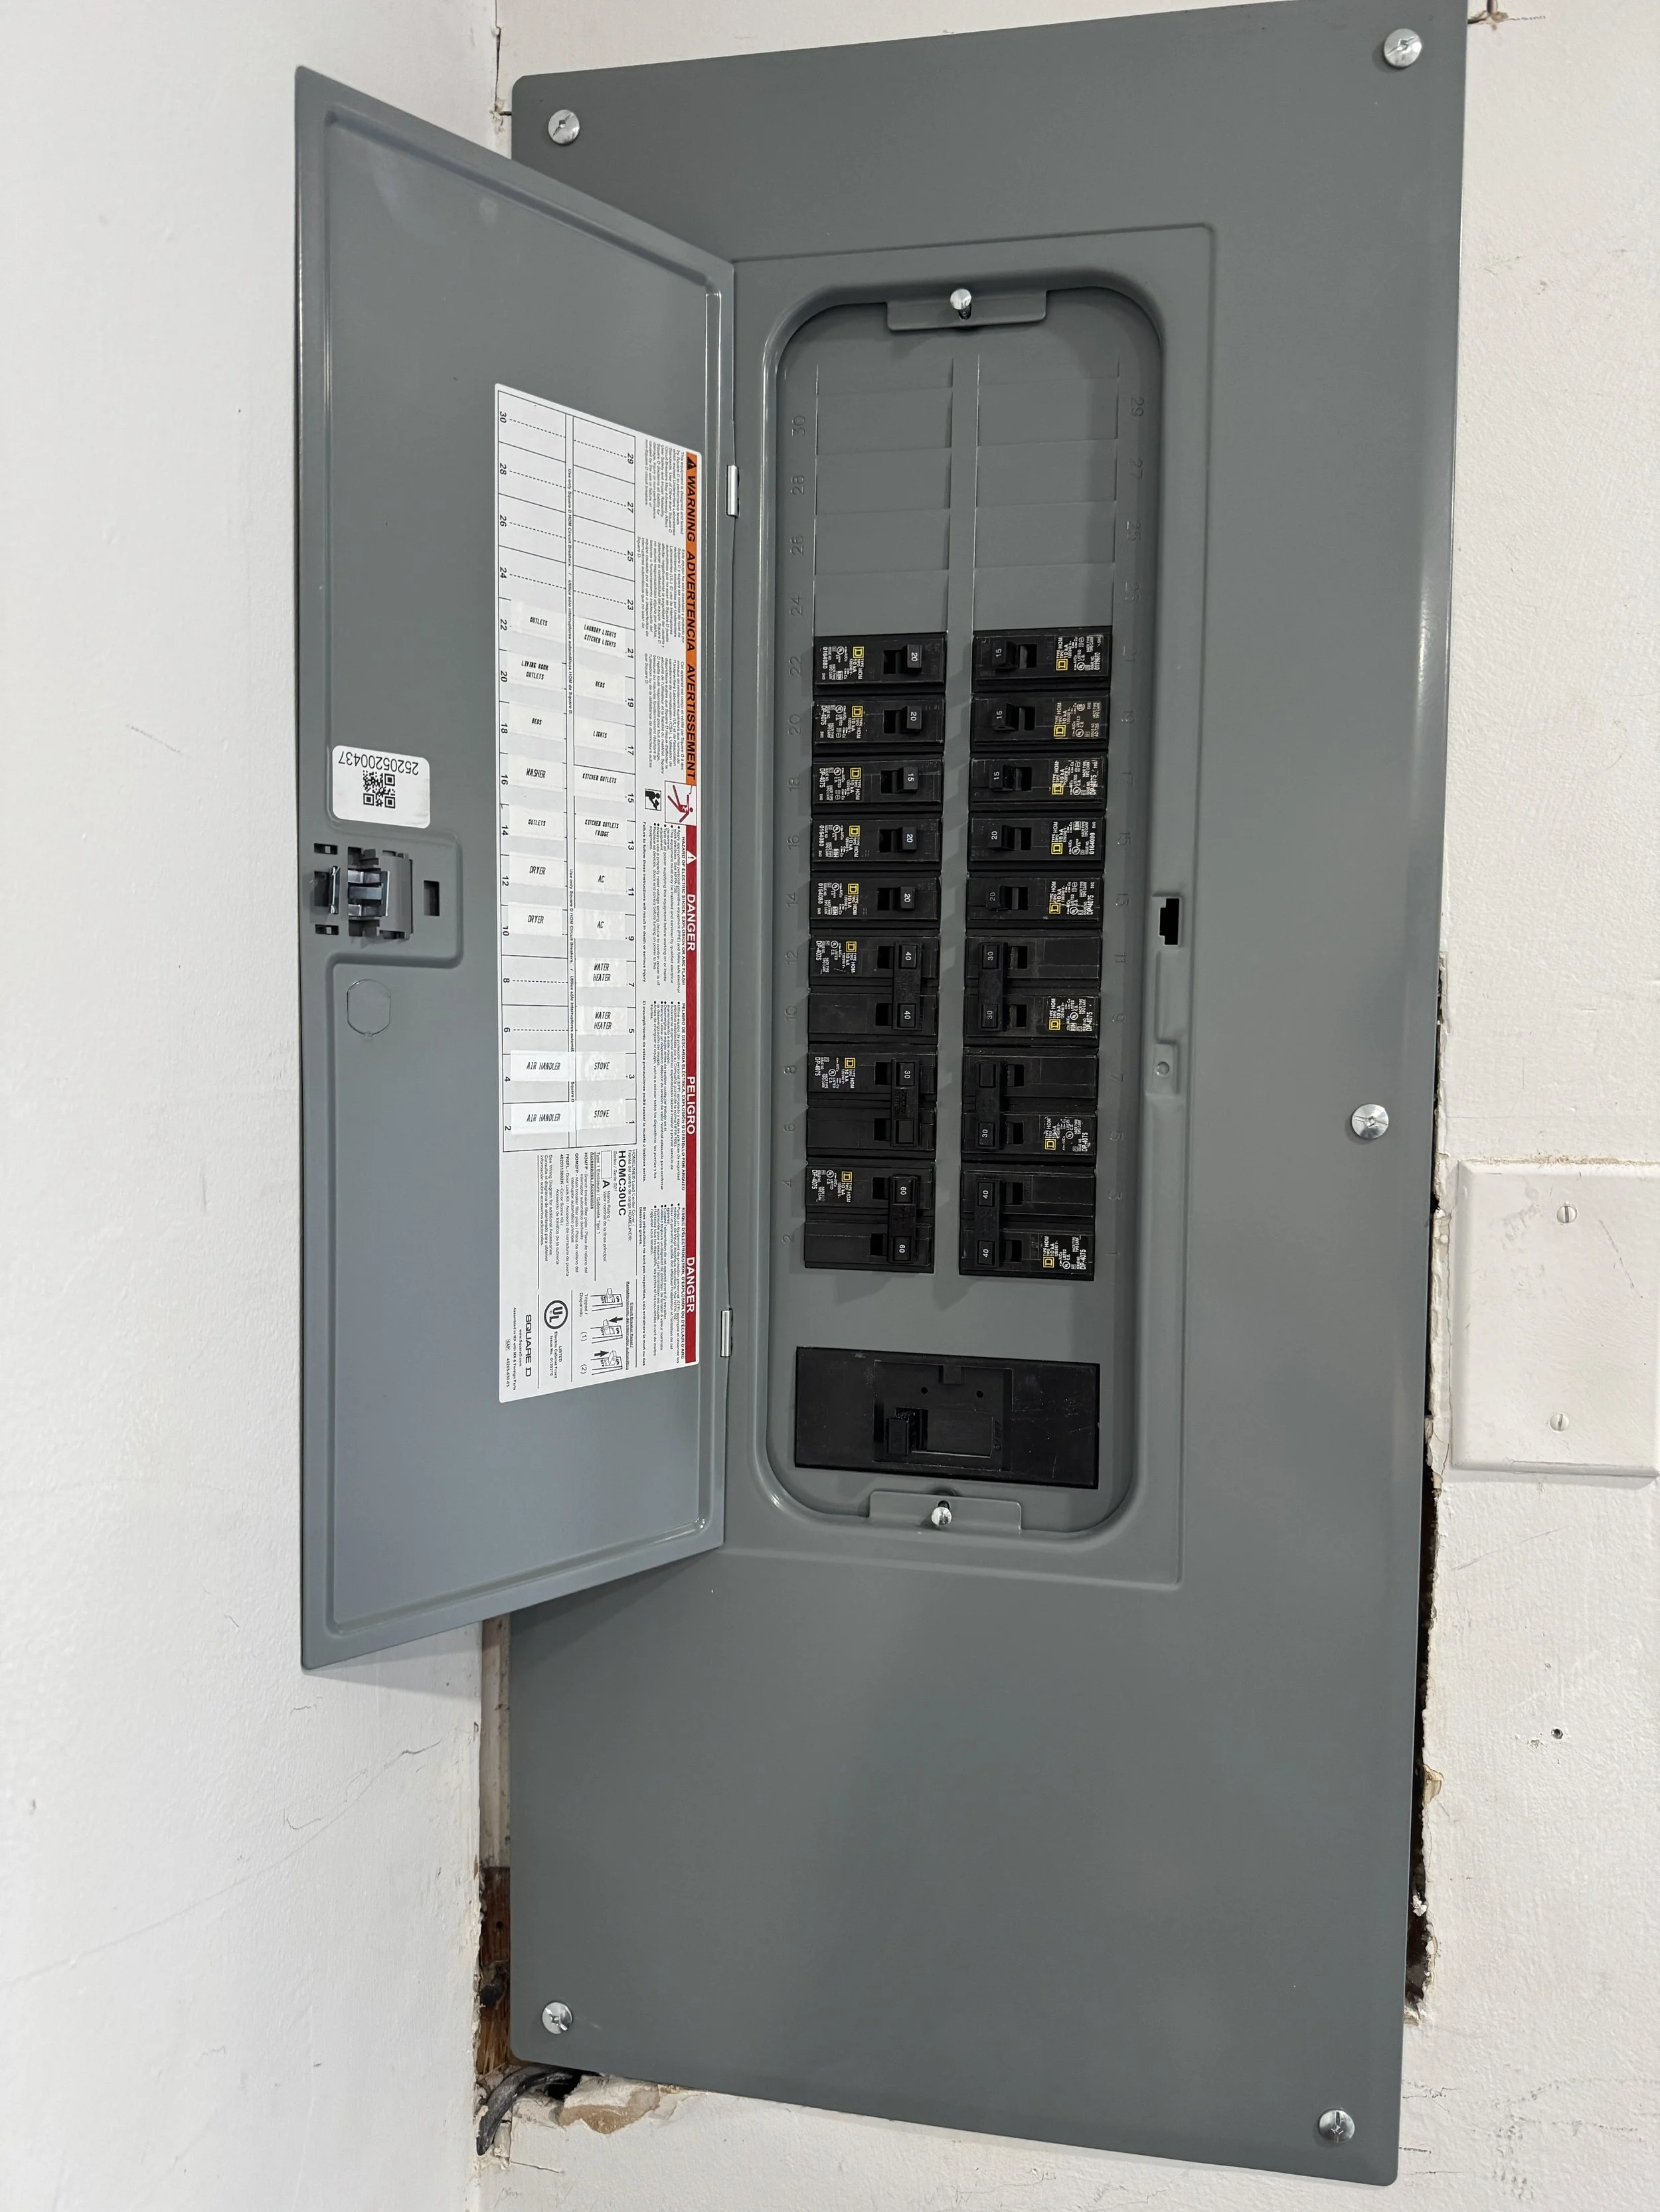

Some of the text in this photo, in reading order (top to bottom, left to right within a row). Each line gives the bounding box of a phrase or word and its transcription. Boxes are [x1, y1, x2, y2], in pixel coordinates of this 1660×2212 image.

[499, 411, 507, 424] 30
[627, 453, 634, 465] 29
[499, 463, 507, 475] 28
[627, 501, 634, 514] 27
[687, 475, 696, 542] WARNING
[499, 514, 507, 527] 26
[627, 550, 633, 562] 25
[499, 566, 507, 579] 24
[627, 599, 634, 611] 23
[687, 550, 696, 652] ADVERTENCIA
[500, 618, 507, 631] 22
[529, 616, 548, 627] OUTLETS
[584, 624, 617, 639] LAUNDRY LIGHTS
[584, 634, 617, 648] KITCHEN LIGHTS
[627, 647, 634, 659] 21
[911, 652, 918, 662] 20
[995, 649, 1002, 657] 15
[521, 660, 537, 669] LIVING
[500, 670, 508, 682] 20
[526, 671, 544, 680] OUTLETS
[627, 697, 634, 708] 19
[910, 711, 917, 722] 20
[996, 710, 1003, 720] 15
[687, 663, 696, 781] AVERTISSEMENT
[501, 723, 508, 734] 18
[592, 730, 608, 739] LIGHTS
[627, 746, 634, 756] 17
[338, 751, 419, 775] 25205200437
[526, 768, 546, 779] WASHER
[582, 773, 617, 784] KITCHEN OUTLETS
[907, 773, 914, 782] 15
[993, 771, 1000, 780] 15
[501, 774, 509, 785] 16
[627, 793, 634, 803] 15
[501, 825, 509, 836] 14
[991, 830, 997, 840] 20
[906, 833, 914, 843] 20
[627, 840, 635, 850] 13
[529, 865, 546, 875] DRYER
[502, 876, 509, 886] 12
[628, 887, 635, 896] 11
[904, 893, 911, 903] 20
[989, 892, 996, 902] 20
[527, 914, 544, 924] DRYER
[687, 894, 696, 951] DANGER
[502, 925, 510, 937] 10
[905, 951, 912, 961] 40
[987, 951, 993, 961] 30
[594, 963, 610, 971] WATER
[592, 973, 611, 982] HEATER
[594, 1011, 612, 1020] WATER
[904, 1010, 911, 1020] 40
[987, 1010, 993, 1020] 30
[526, 1062, 561, 1071] AIR HANDLER
[594, 1062, 610, 1070] STOVE
[904, 1070, 911, 1079] 30
[687, 1076, 696, 1135] PELIGRO
[526, 1113, 561, 1123] AIR HANDLER
[593, 1109, 610, 1118] STOVE
[981, 1129, 988, 1138] 30
[602, 1180, 610, 1189] A
[900, 1186, 907, 1196] 60
[982, 1190, 989, 1199] 40
[898, 1244, 906, 1253] 60
[983, 1249, 989, 1258] 40
[685, 1257, 695, 1314] DANGER
[525, 1366, 532, 1377] D
